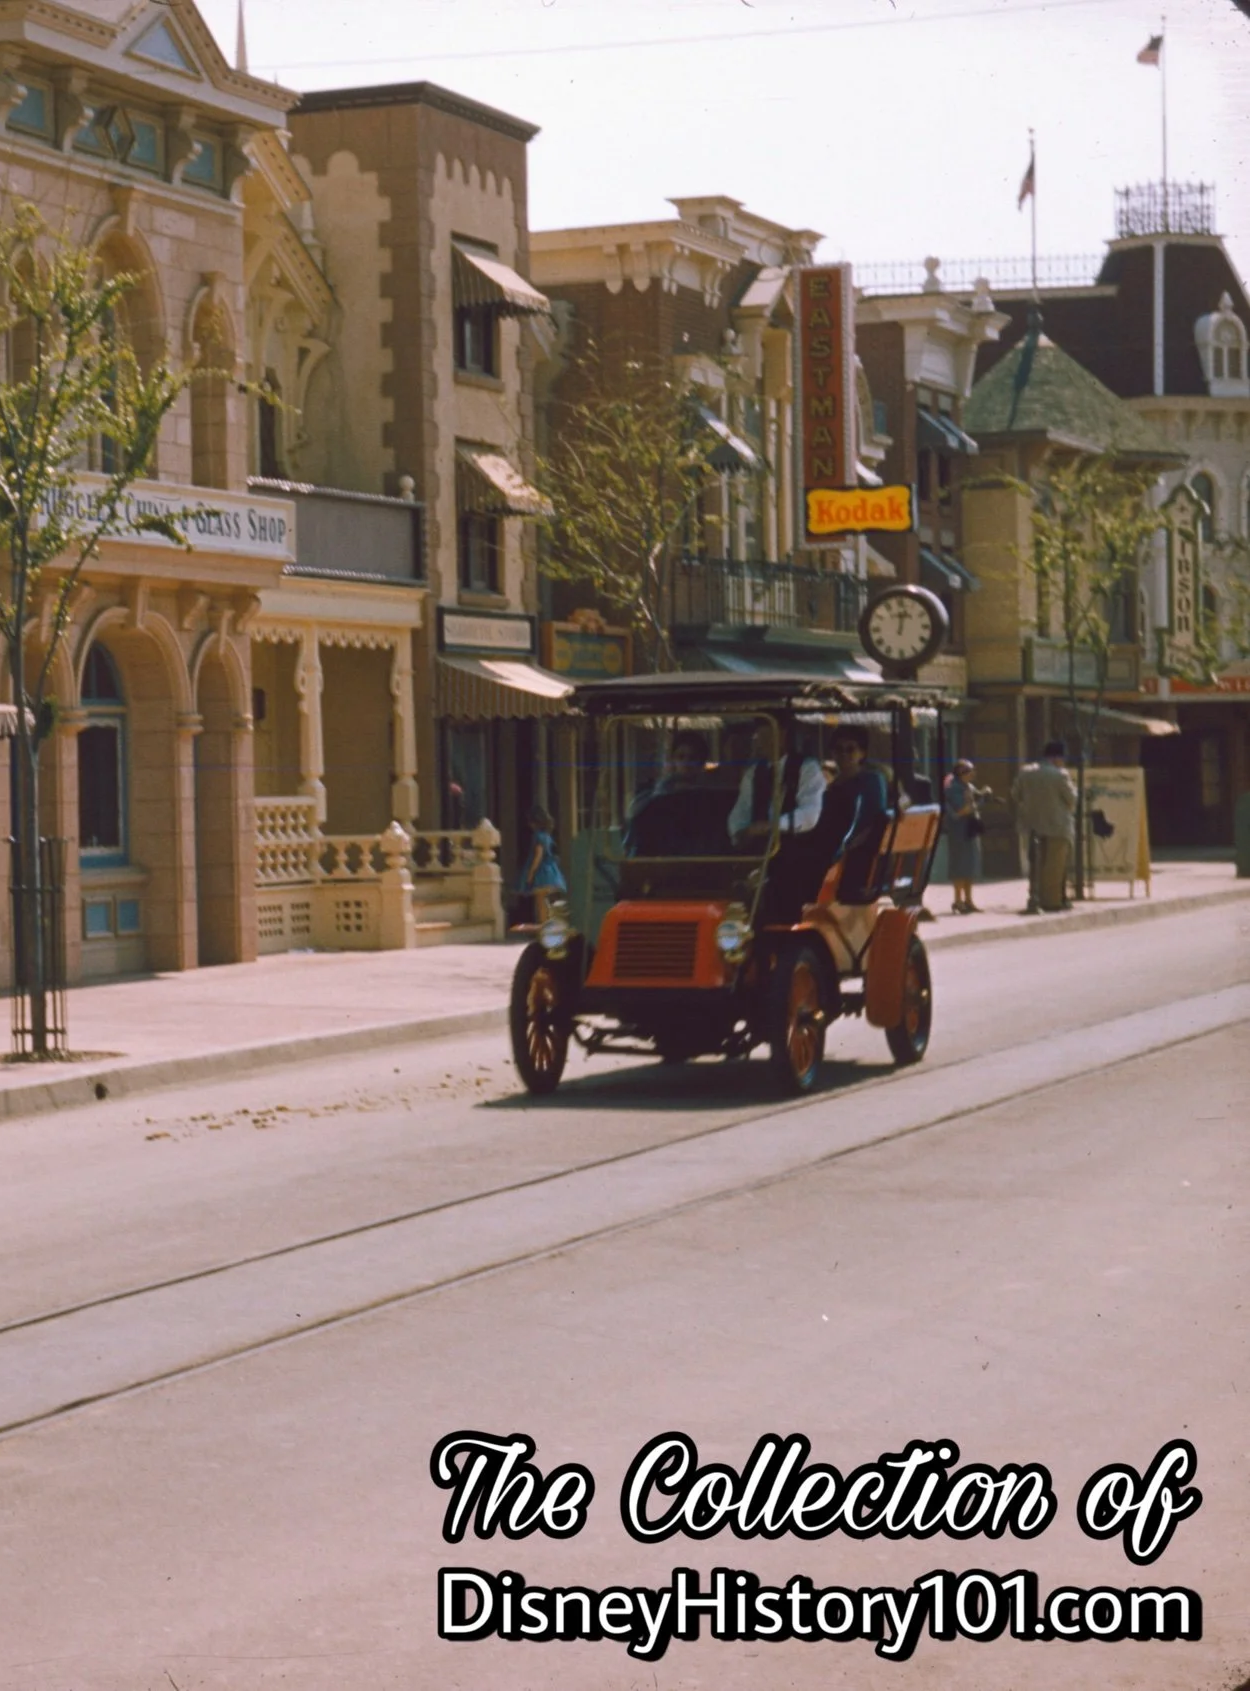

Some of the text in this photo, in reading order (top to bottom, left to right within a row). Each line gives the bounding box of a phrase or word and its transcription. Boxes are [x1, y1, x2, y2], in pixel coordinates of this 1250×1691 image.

[808, 275, 835, 480] EASTMAN
[195, 501, 241, 540] GLASS
[247, 508, 287, 545] SHOP
[814, 495, 905, 525] Kodak
